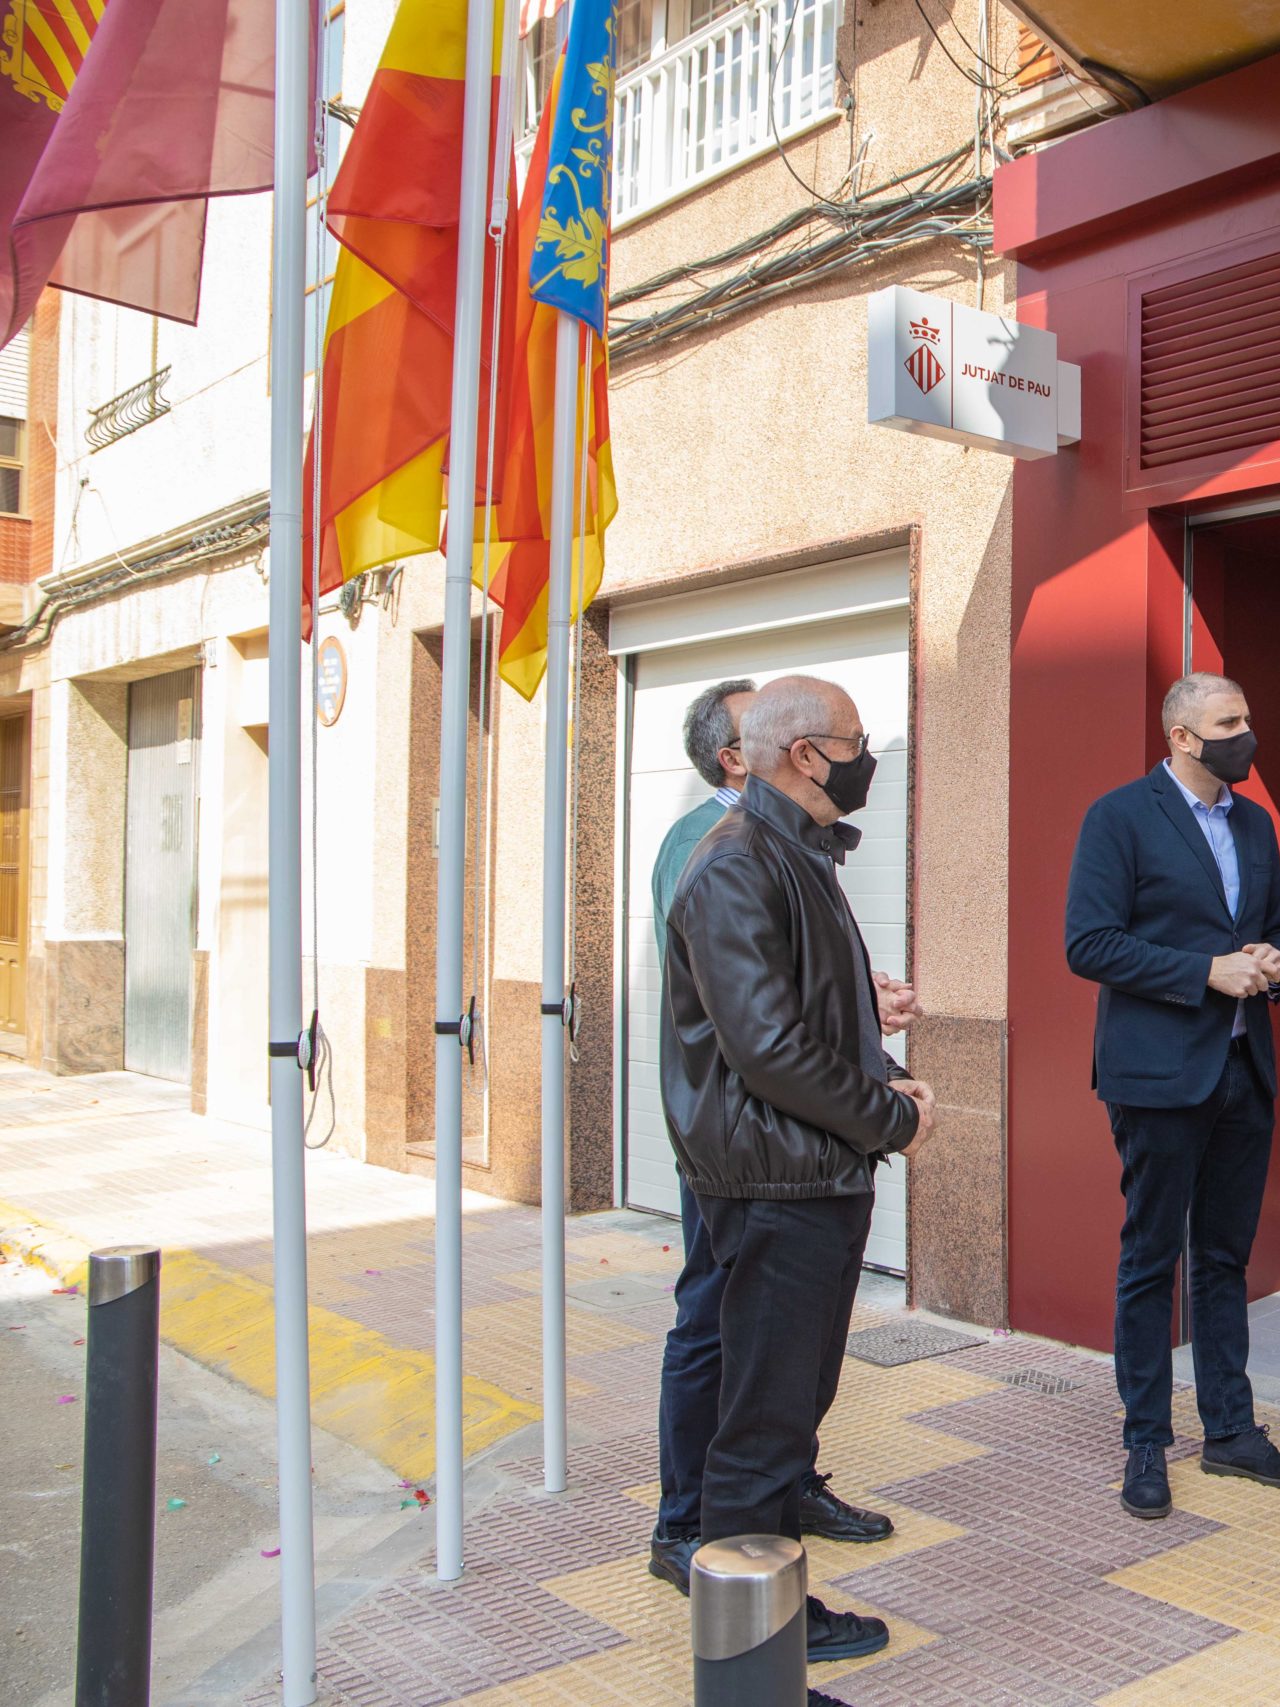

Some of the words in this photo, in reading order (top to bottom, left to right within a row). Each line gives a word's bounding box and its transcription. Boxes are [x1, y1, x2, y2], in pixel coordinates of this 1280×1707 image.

[961, 363, 1006, 385] JUTJAT
[1008, 375, 1025, 391] DE
[1027, 380, 1051, 397] PAU
